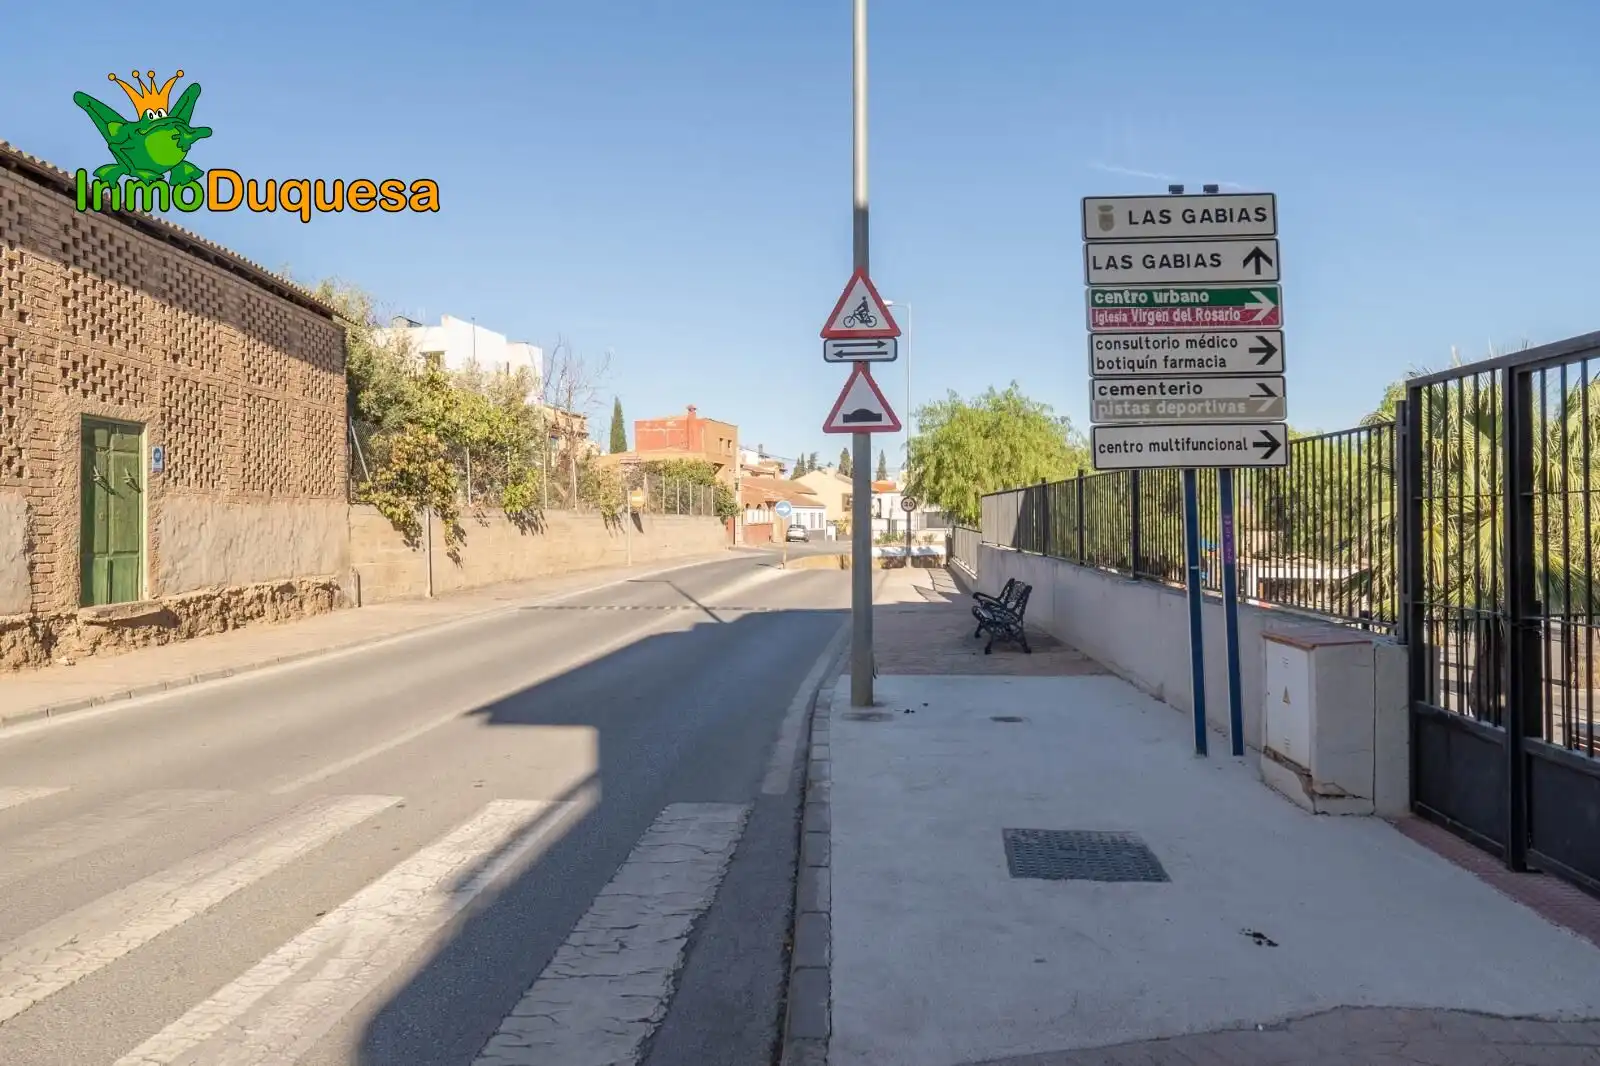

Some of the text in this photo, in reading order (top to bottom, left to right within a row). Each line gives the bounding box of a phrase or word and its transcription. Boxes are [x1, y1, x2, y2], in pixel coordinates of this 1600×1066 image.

[1129, 207, 1267, 225] LAS GABIAS
[1093, 253, 1222, 270] LAS GABIAS
[1095, 289, 1209, 304] centro urbano
[1131, 308, 1169, 323] Virgen
[1173, 308, 1192, 322] del
[1195, 307, 1240, 321] Rosario
[1096, 335, 1238, 350] consultorio médico
[1097, 355, 1226, 372] botiquín farmacia
[1098, 382, 1203, 396] cementerio
[1099, 398, 1246, 418] pistas deportivas
[1099, 437, 1247, 454] centro multifuncional
